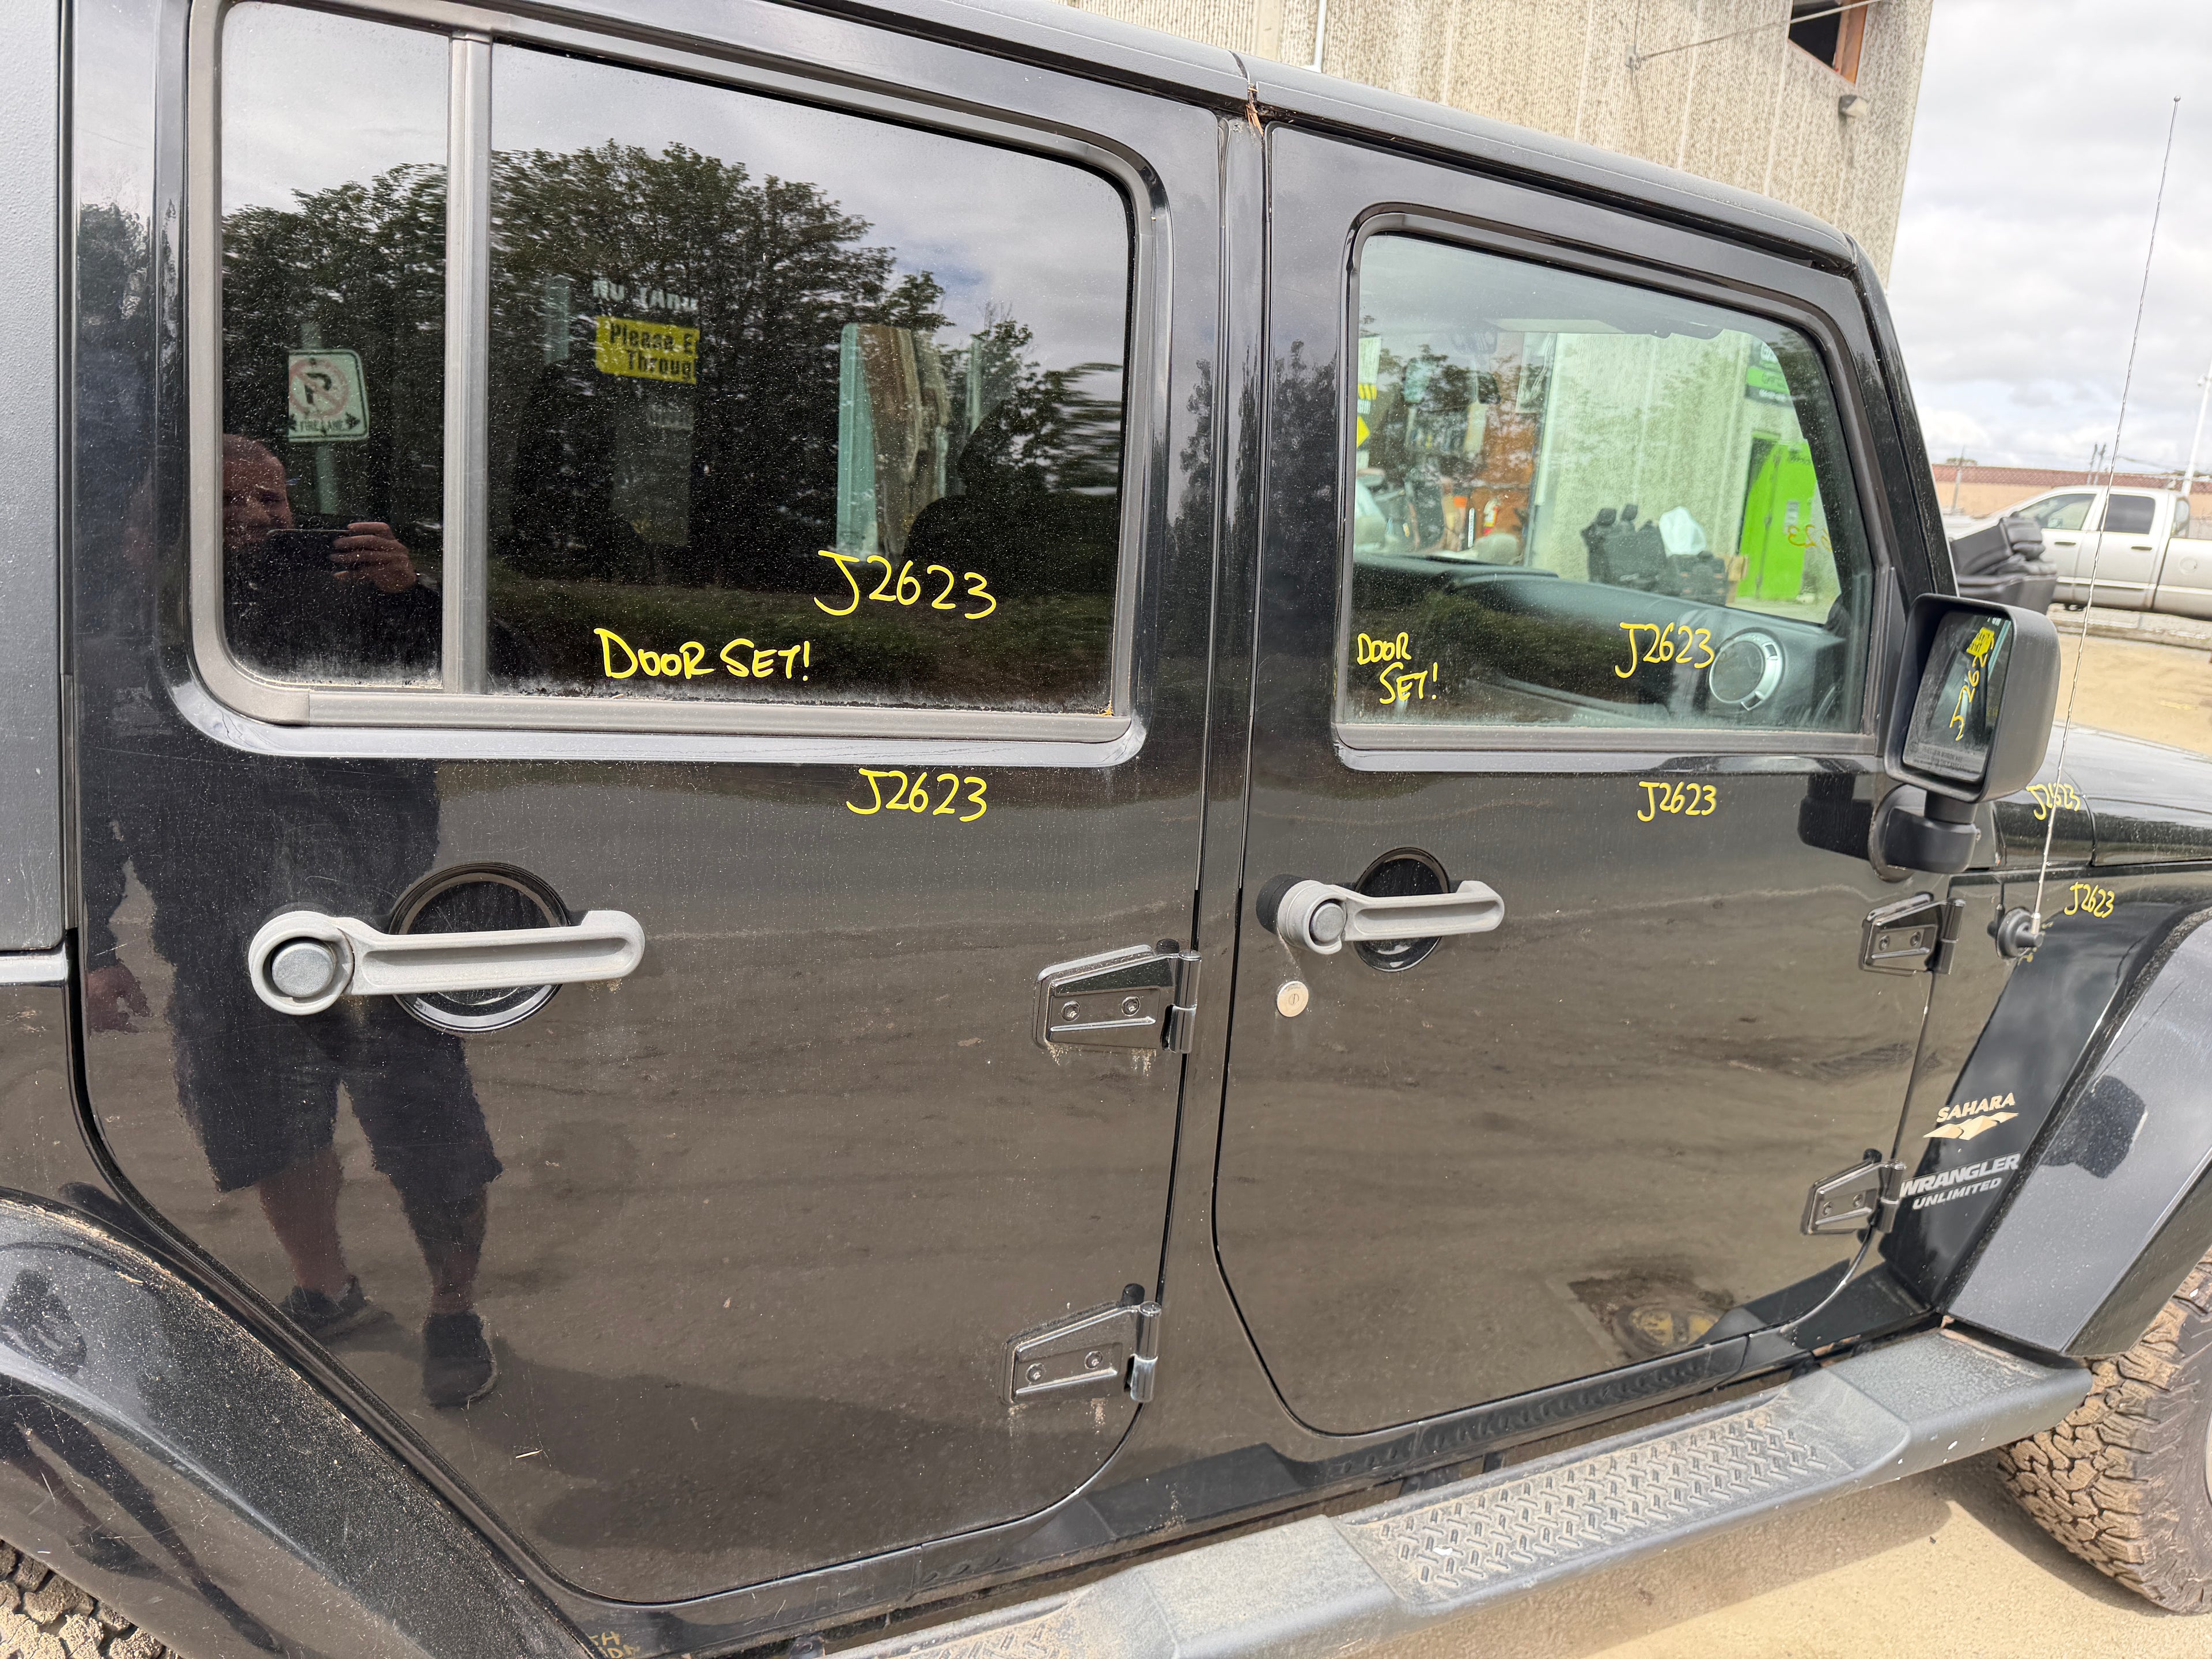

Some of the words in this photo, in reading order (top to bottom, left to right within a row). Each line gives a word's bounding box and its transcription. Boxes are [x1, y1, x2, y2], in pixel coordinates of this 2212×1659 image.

[814, 550, 997, 620] J2623
[720, 638, 810, 681] SET!
[1357, 631, 1412, 665] DOOR
[1615, 622, 1715, 679] J2623
[1379, 662, 1439, 704] SET!
[846, 767, 988, 823] J2623
[1637, 781, 1717, 822] J2623
[2025, 782, 2081, 821] J2623
[2063, 881, 2115, 918] J2623
[1936, 1092, 2016, 1123] SAHARA
[1900, 1153, 2021, 1198] WRANGLER
[1912, 1177, 2002, 1210] UNLIMITED
